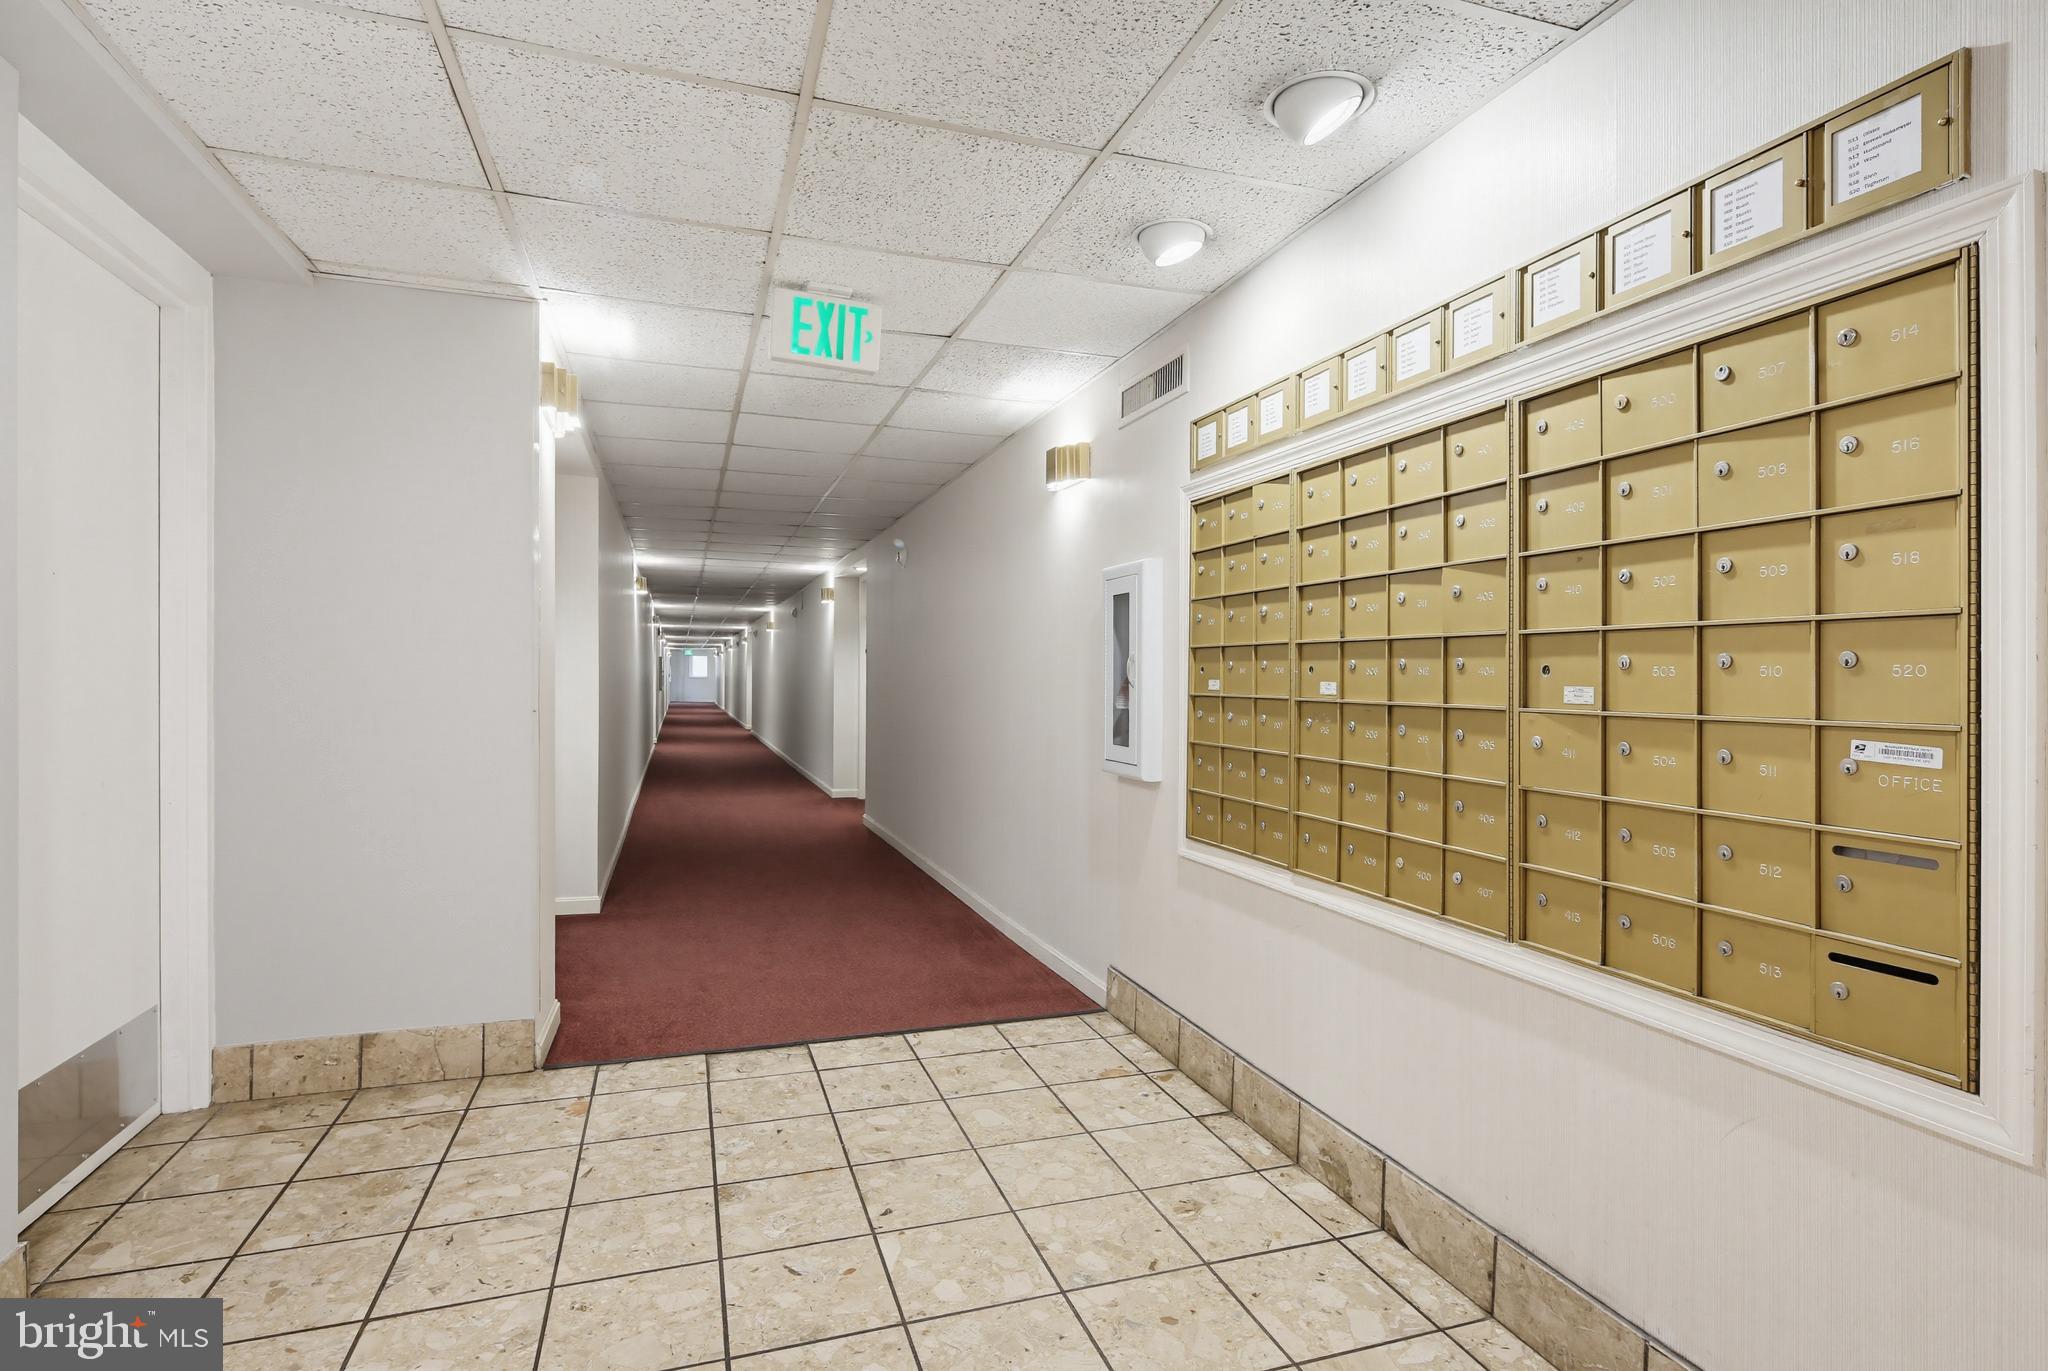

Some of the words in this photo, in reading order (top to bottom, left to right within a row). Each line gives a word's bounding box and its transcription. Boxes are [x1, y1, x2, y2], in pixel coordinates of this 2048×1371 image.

[790, 296, 868, 363] EXIT
[1890, 323, 1920, 342] 514
[1757, 360, 1787, 379] 507
[1891, 436, 1921, 454] 516
[1757, 462, 1788, 479] 508
[1891, 550, 1921, 566] 518
[1759, 563, 1789, 578] 509
[1653, 575, 1676, 588] 502
[1759, 665, 1783, 678] 510
[1891, 664, 1927, 678] 520
[1652, 755, 1677, 767] 504
[1759, 764, 1777, 777] 511
[1878, 774, 1943, 793] OFFICE
[1652, 844, 1677, 859] 505
[1759, 863, 1782, 879] 512
[1652, 933, 1676, 949] 506
[1759, 962, 1783, 979] 513
